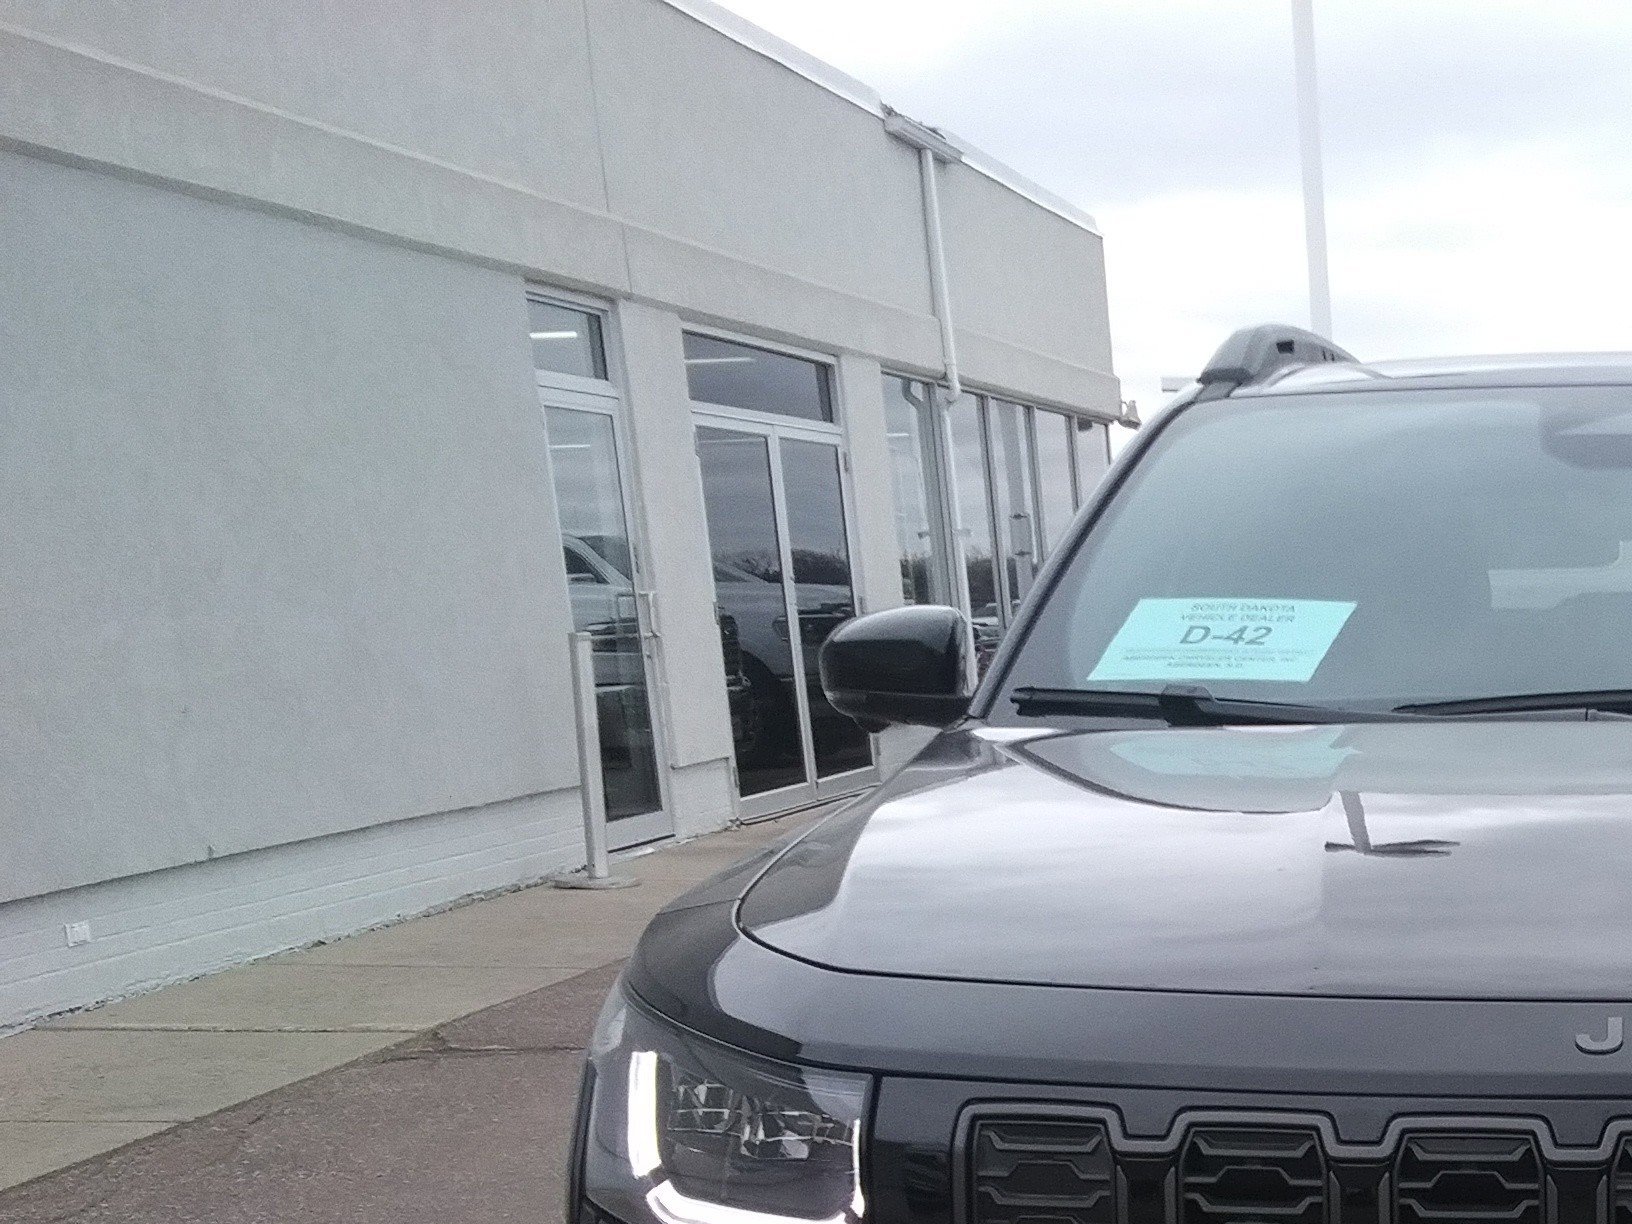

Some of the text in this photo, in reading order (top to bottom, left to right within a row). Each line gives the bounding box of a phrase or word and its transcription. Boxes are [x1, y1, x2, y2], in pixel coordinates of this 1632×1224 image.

[1190, 603, 1296, 613] SOUTH DAKOTA
[1179, 624, 1274, 646] D-42
